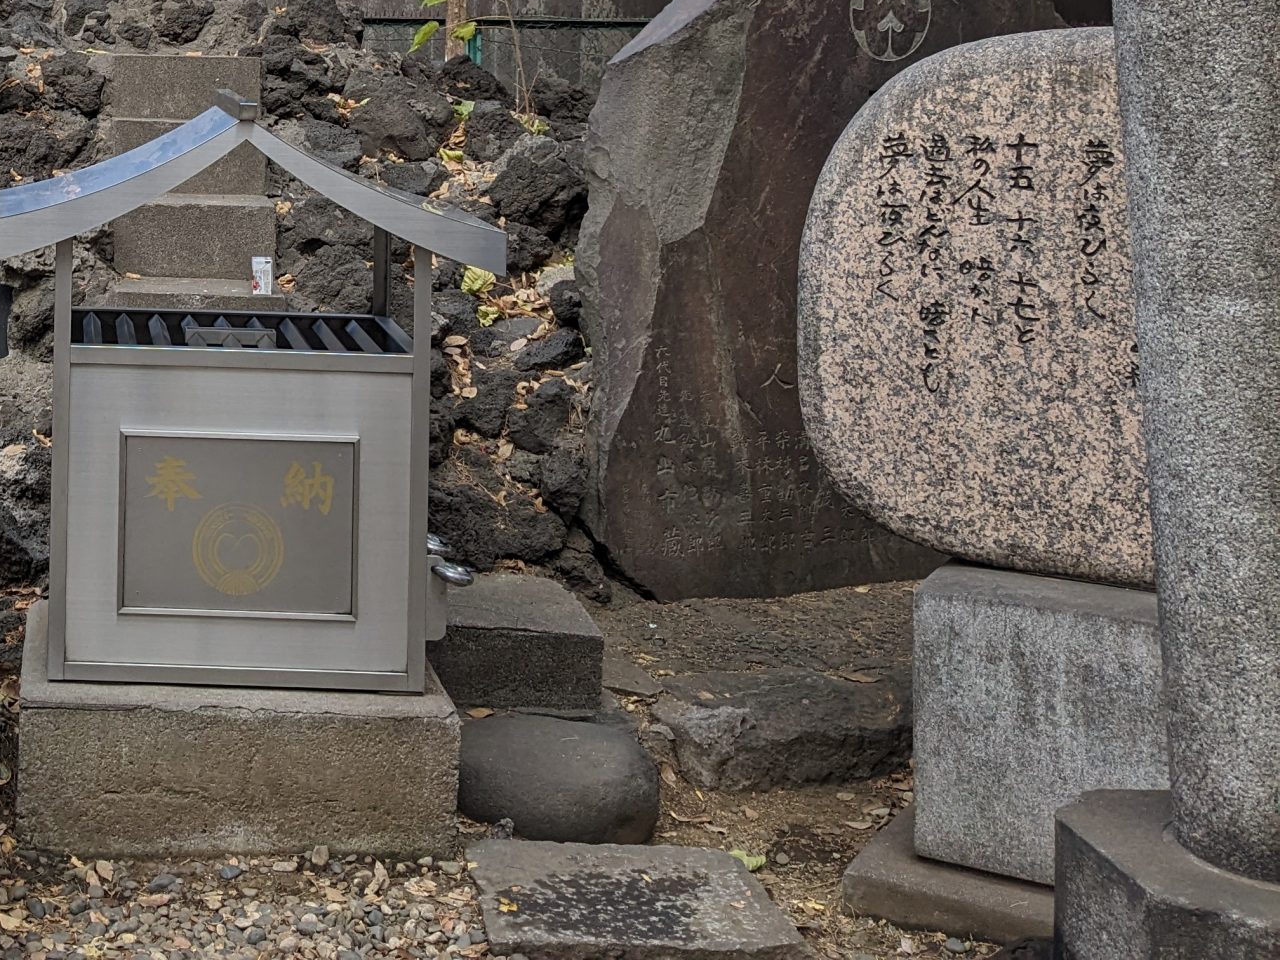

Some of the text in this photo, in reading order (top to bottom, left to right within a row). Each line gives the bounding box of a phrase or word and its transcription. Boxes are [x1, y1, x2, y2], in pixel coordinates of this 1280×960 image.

[953, 135, 996, 227] 私の人生
[1006, 132, 1040, 192] 十五
[876, 132, 914, 302] 夢は夜ひらく
[1006, 210, 1040, 254] 十六
[1077, 139, 1115, 321] 夢は夜ひらく
